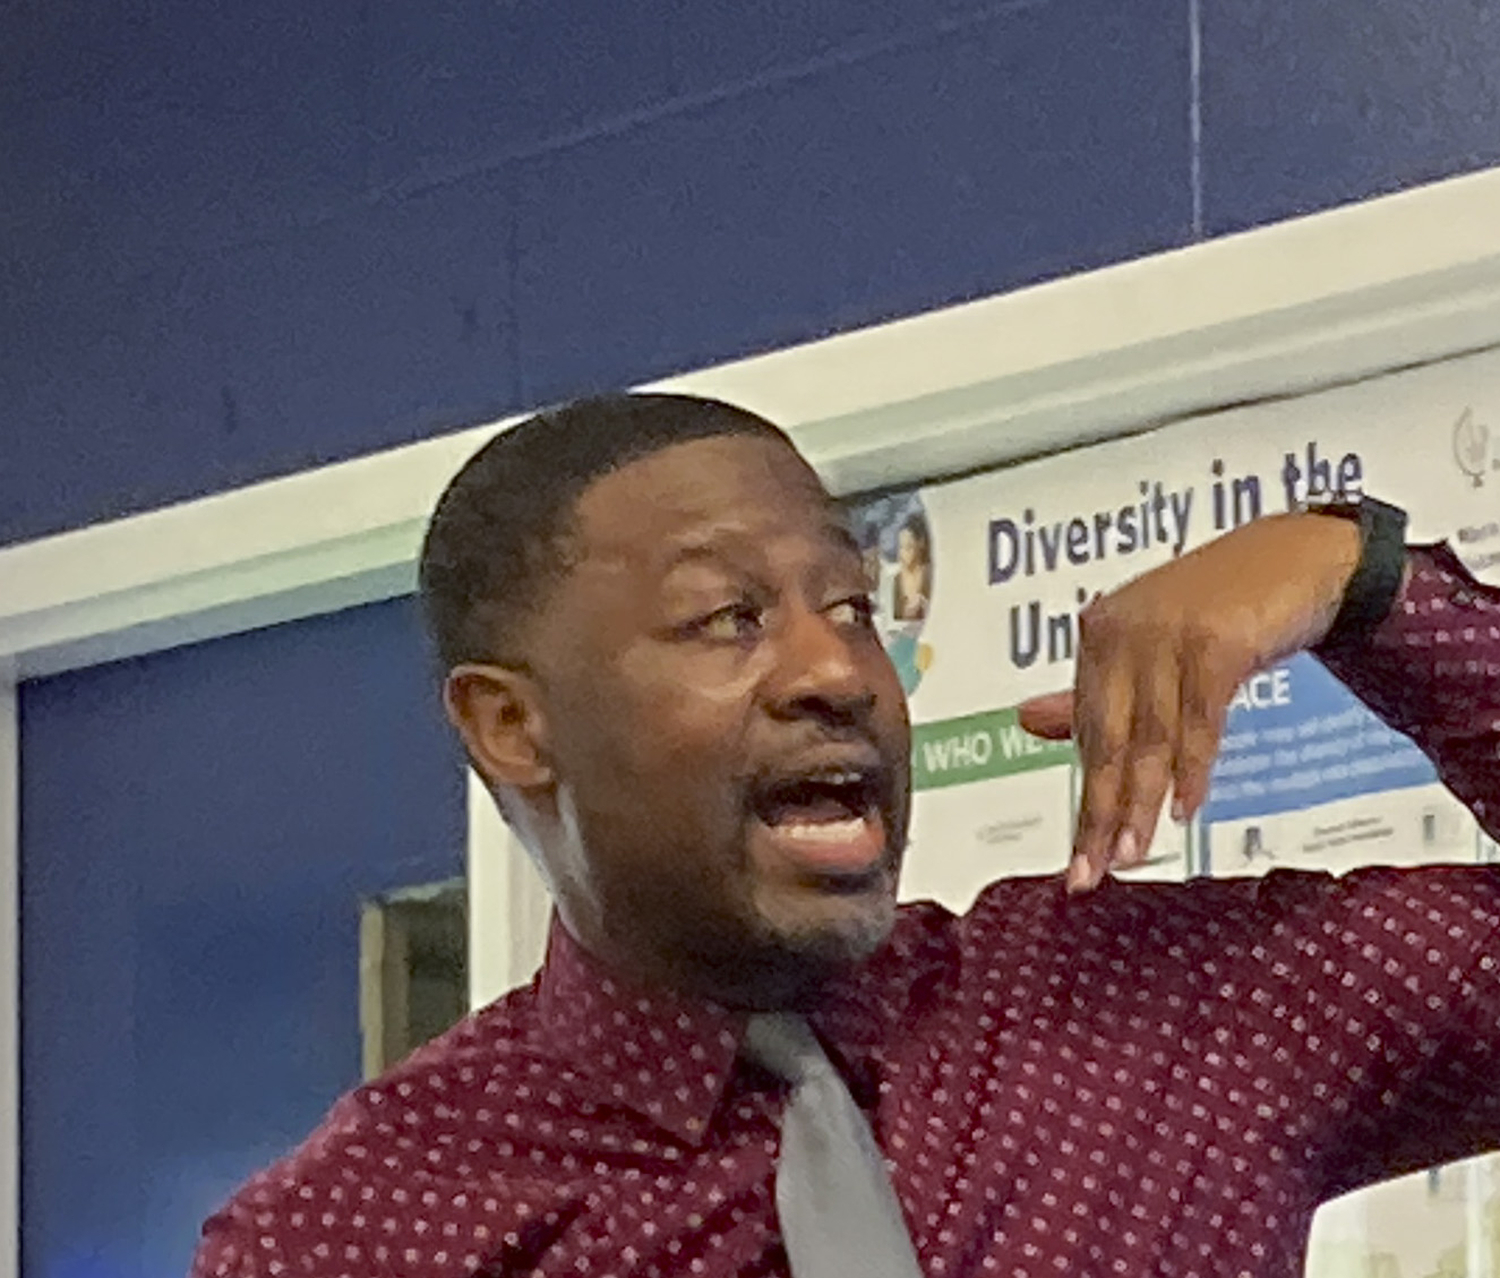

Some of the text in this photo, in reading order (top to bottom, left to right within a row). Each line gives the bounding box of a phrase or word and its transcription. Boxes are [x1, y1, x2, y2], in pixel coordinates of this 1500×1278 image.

[987, 441, 1362, 586] Diversity in the
[923, 731, 993, 773] WHO
